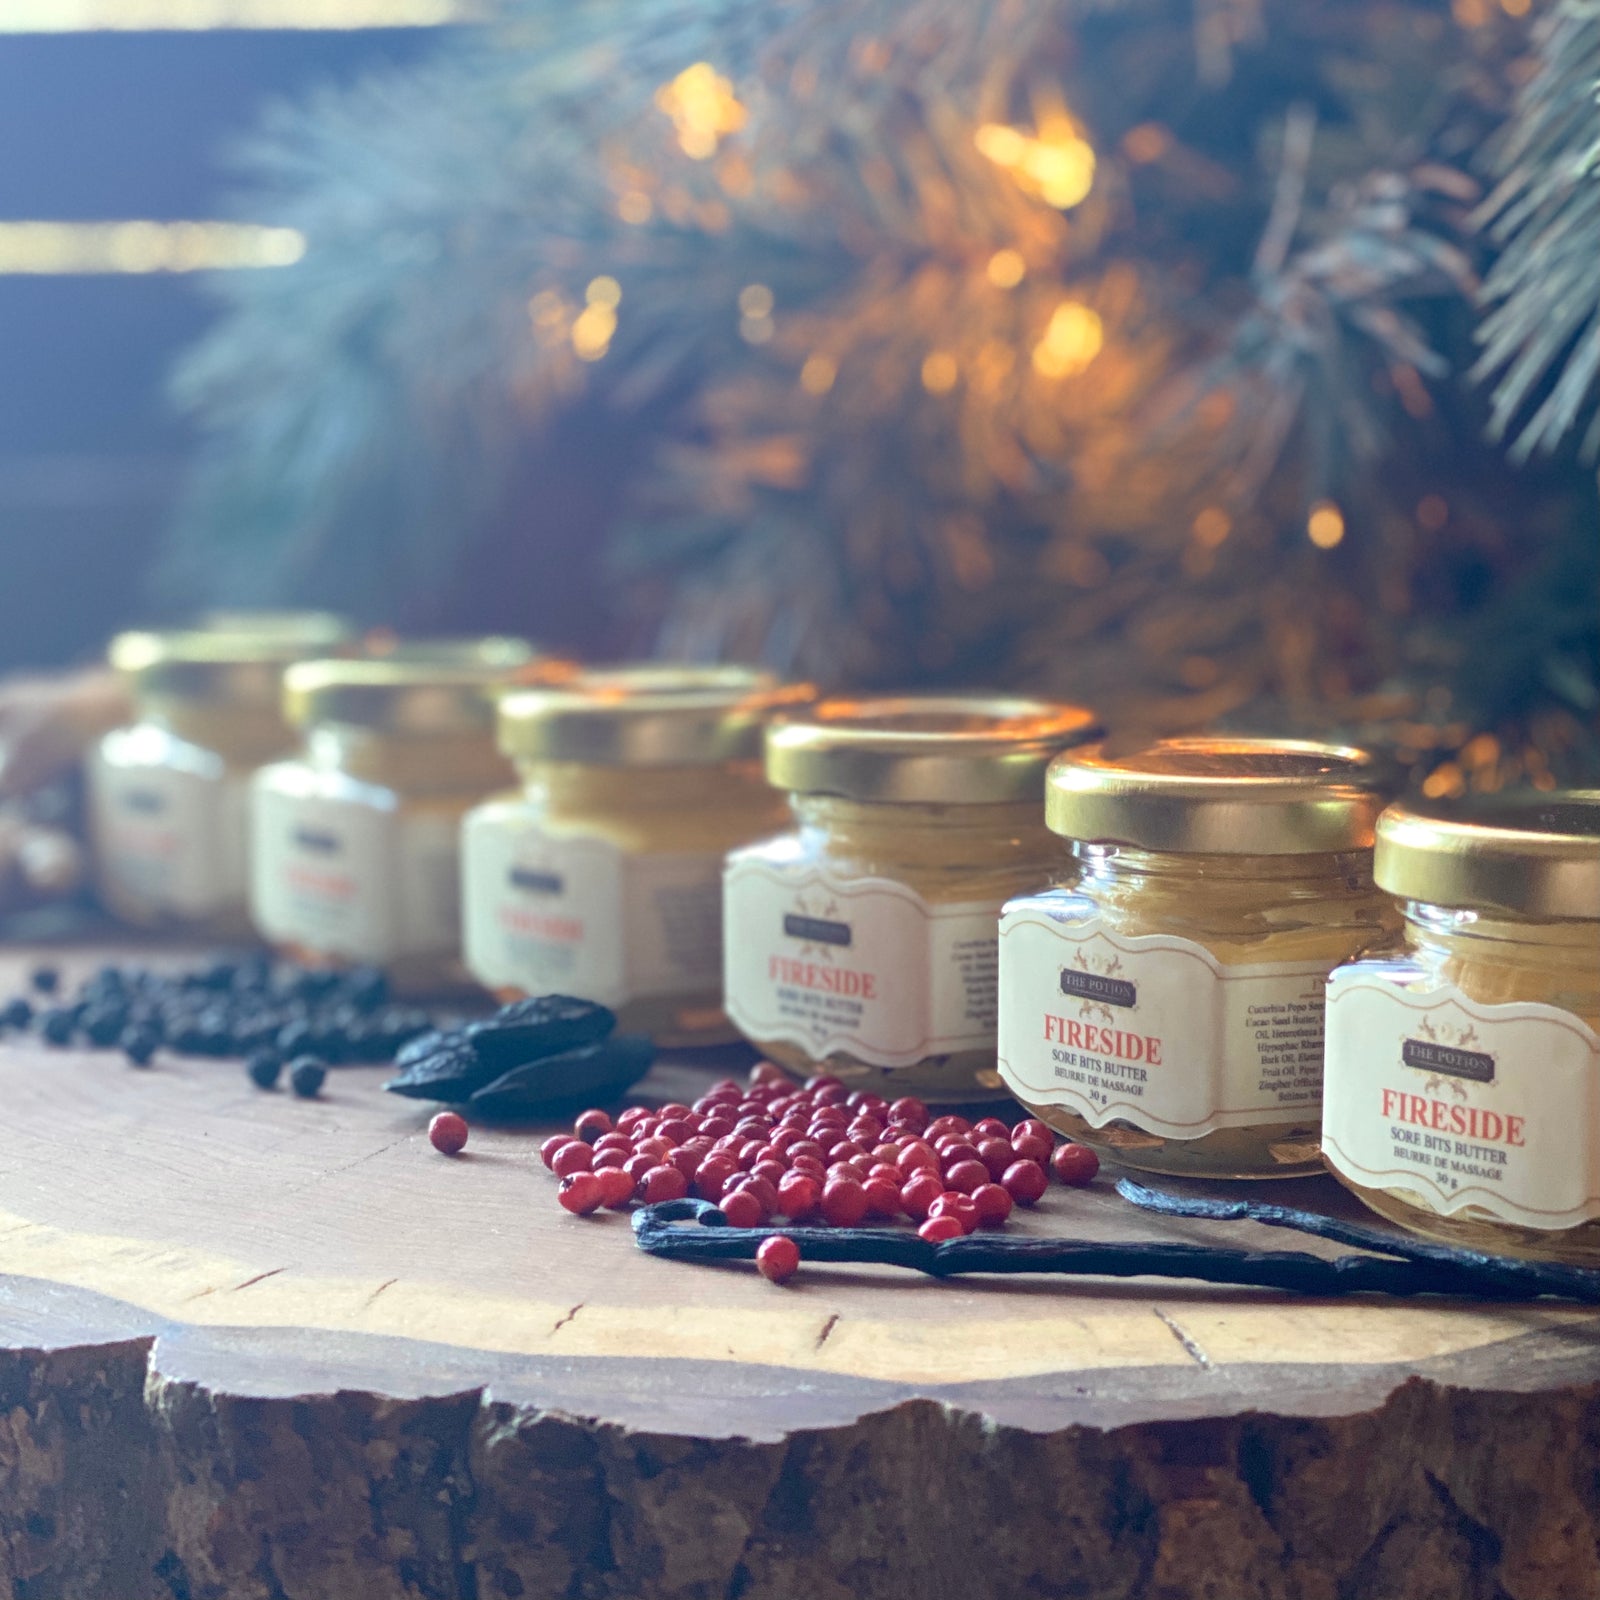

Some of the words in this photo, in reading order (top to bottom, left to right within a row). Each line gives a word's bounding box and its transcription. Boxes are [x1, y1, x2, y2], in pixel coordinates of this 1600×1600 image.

[769, 955, 876, 1000] FIRESIDE
[1065, 974, 1085, 987] THE
[1089, 980, 1131, 997] POTION
[1044, 1013, 1162, 1066] FIRESIDE
[1052, 1049, 1077, 1066] SORE
[1080, 1055, 1102, 1072] BITS
[1104, 1061, 1147, 1081] BUTTER
[1408, 1044, 1433, 1060] THE
[1437, 1052, 1488, 1070] POTION
[1055, 1066, 1085, 1083] BEURRE
[1088, 1075, 1099, 1087] DE
[1101, 1079, 1143, 1096] MASSAGE
[1089, 1089, 1100, 1101] 30
[1101, 1095, 1107, 1105] g
[1381, 1088, 1526, 1147] FIRESIDE
[1391, 1126, 1421, 1145] SORE
[1424, 1135, 1452, 1153] BITS
[1455, 1141, 1507, 1165] BUTTER
[1393, 1146, 1432, 1165] BEURRE
[1434, 1155, 1448, 1169] DE
[1451, 1161, 1503, 1181] MASSAGE
[1436, 1172, 1449, 1184] 30
[1450, 1178, 1458, 1189] g
